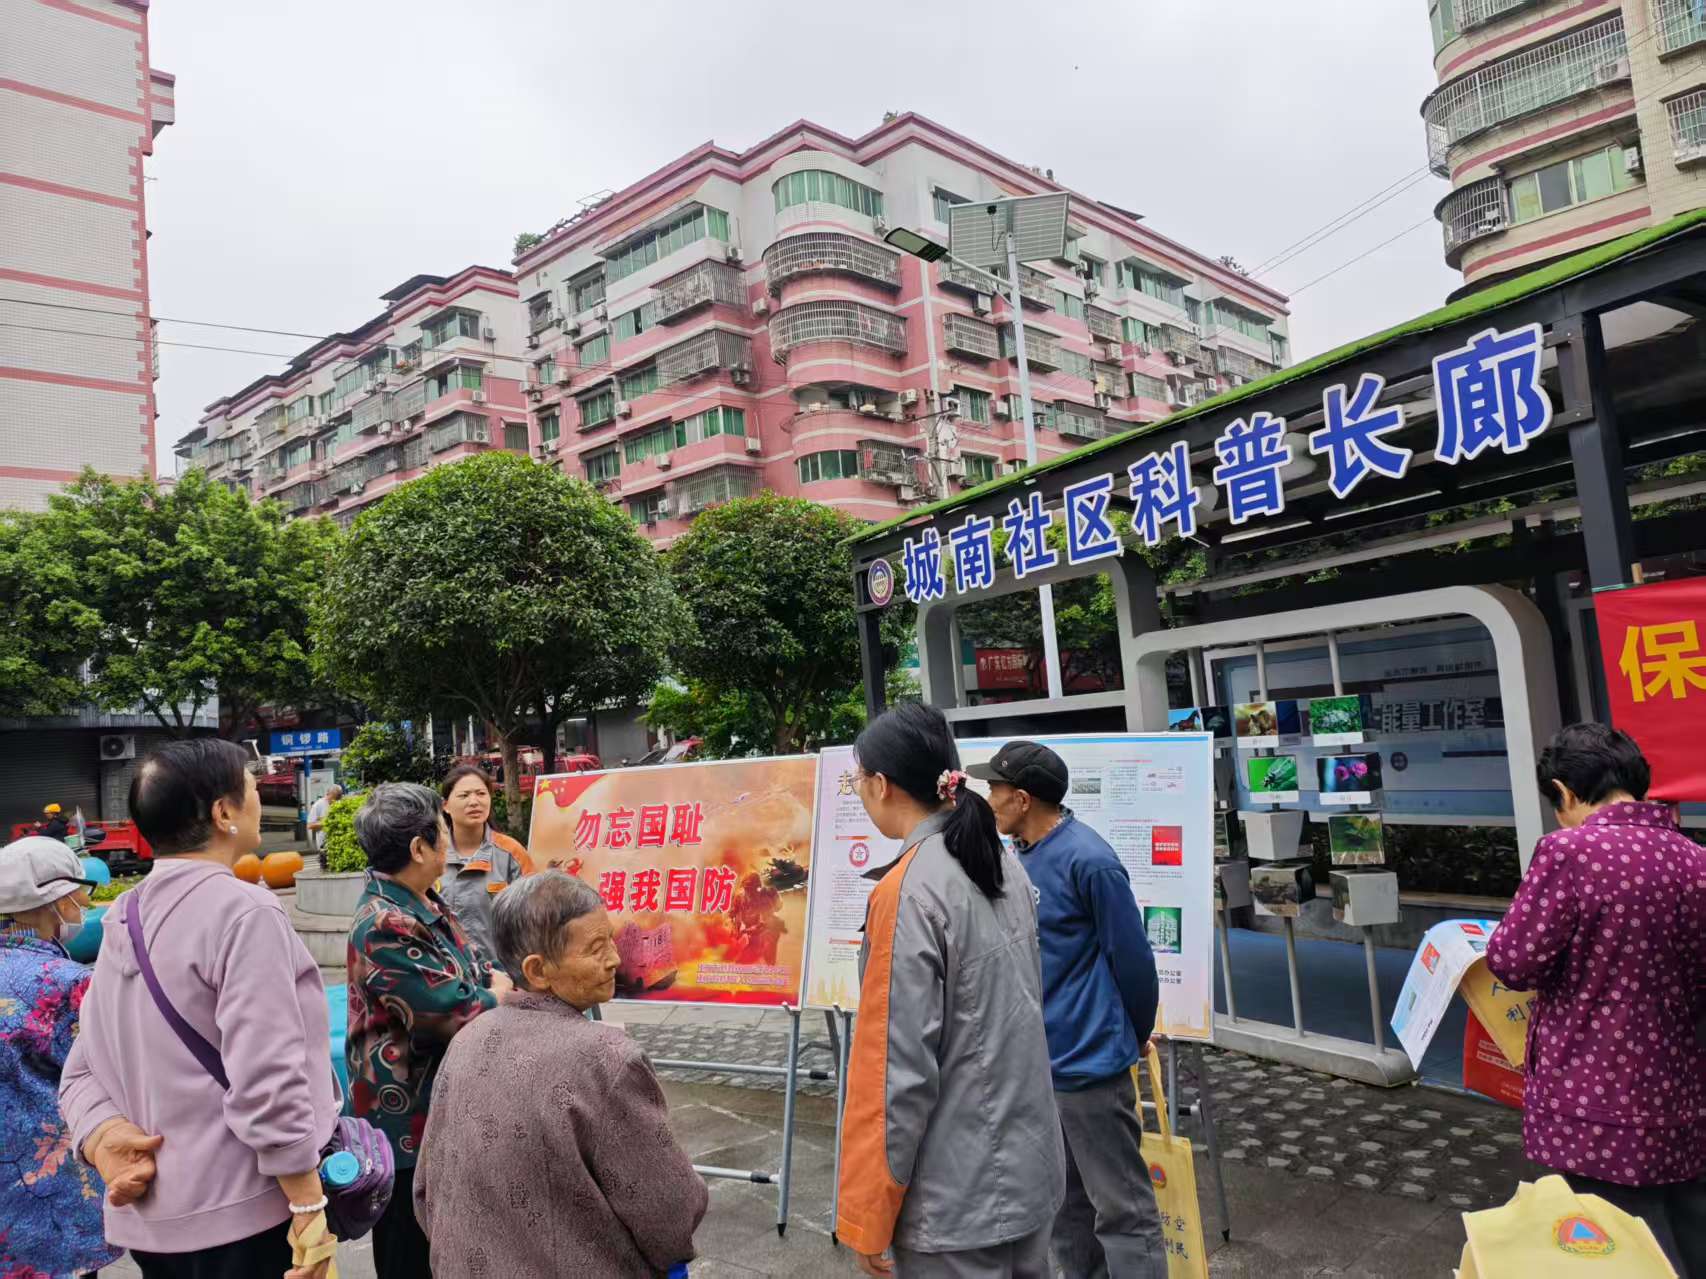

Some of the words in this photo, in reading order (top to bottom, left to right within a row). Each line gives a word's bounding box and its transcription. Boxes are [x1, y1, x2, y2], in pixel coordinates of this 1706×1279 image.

[903, 323, 1552, 602] 城南社区科普长廊
[1618, 619, 1706, 702] 保
[574, 803, 704, 850] 勿忘国耻
[600, 866, 737, 914] 强我国防
